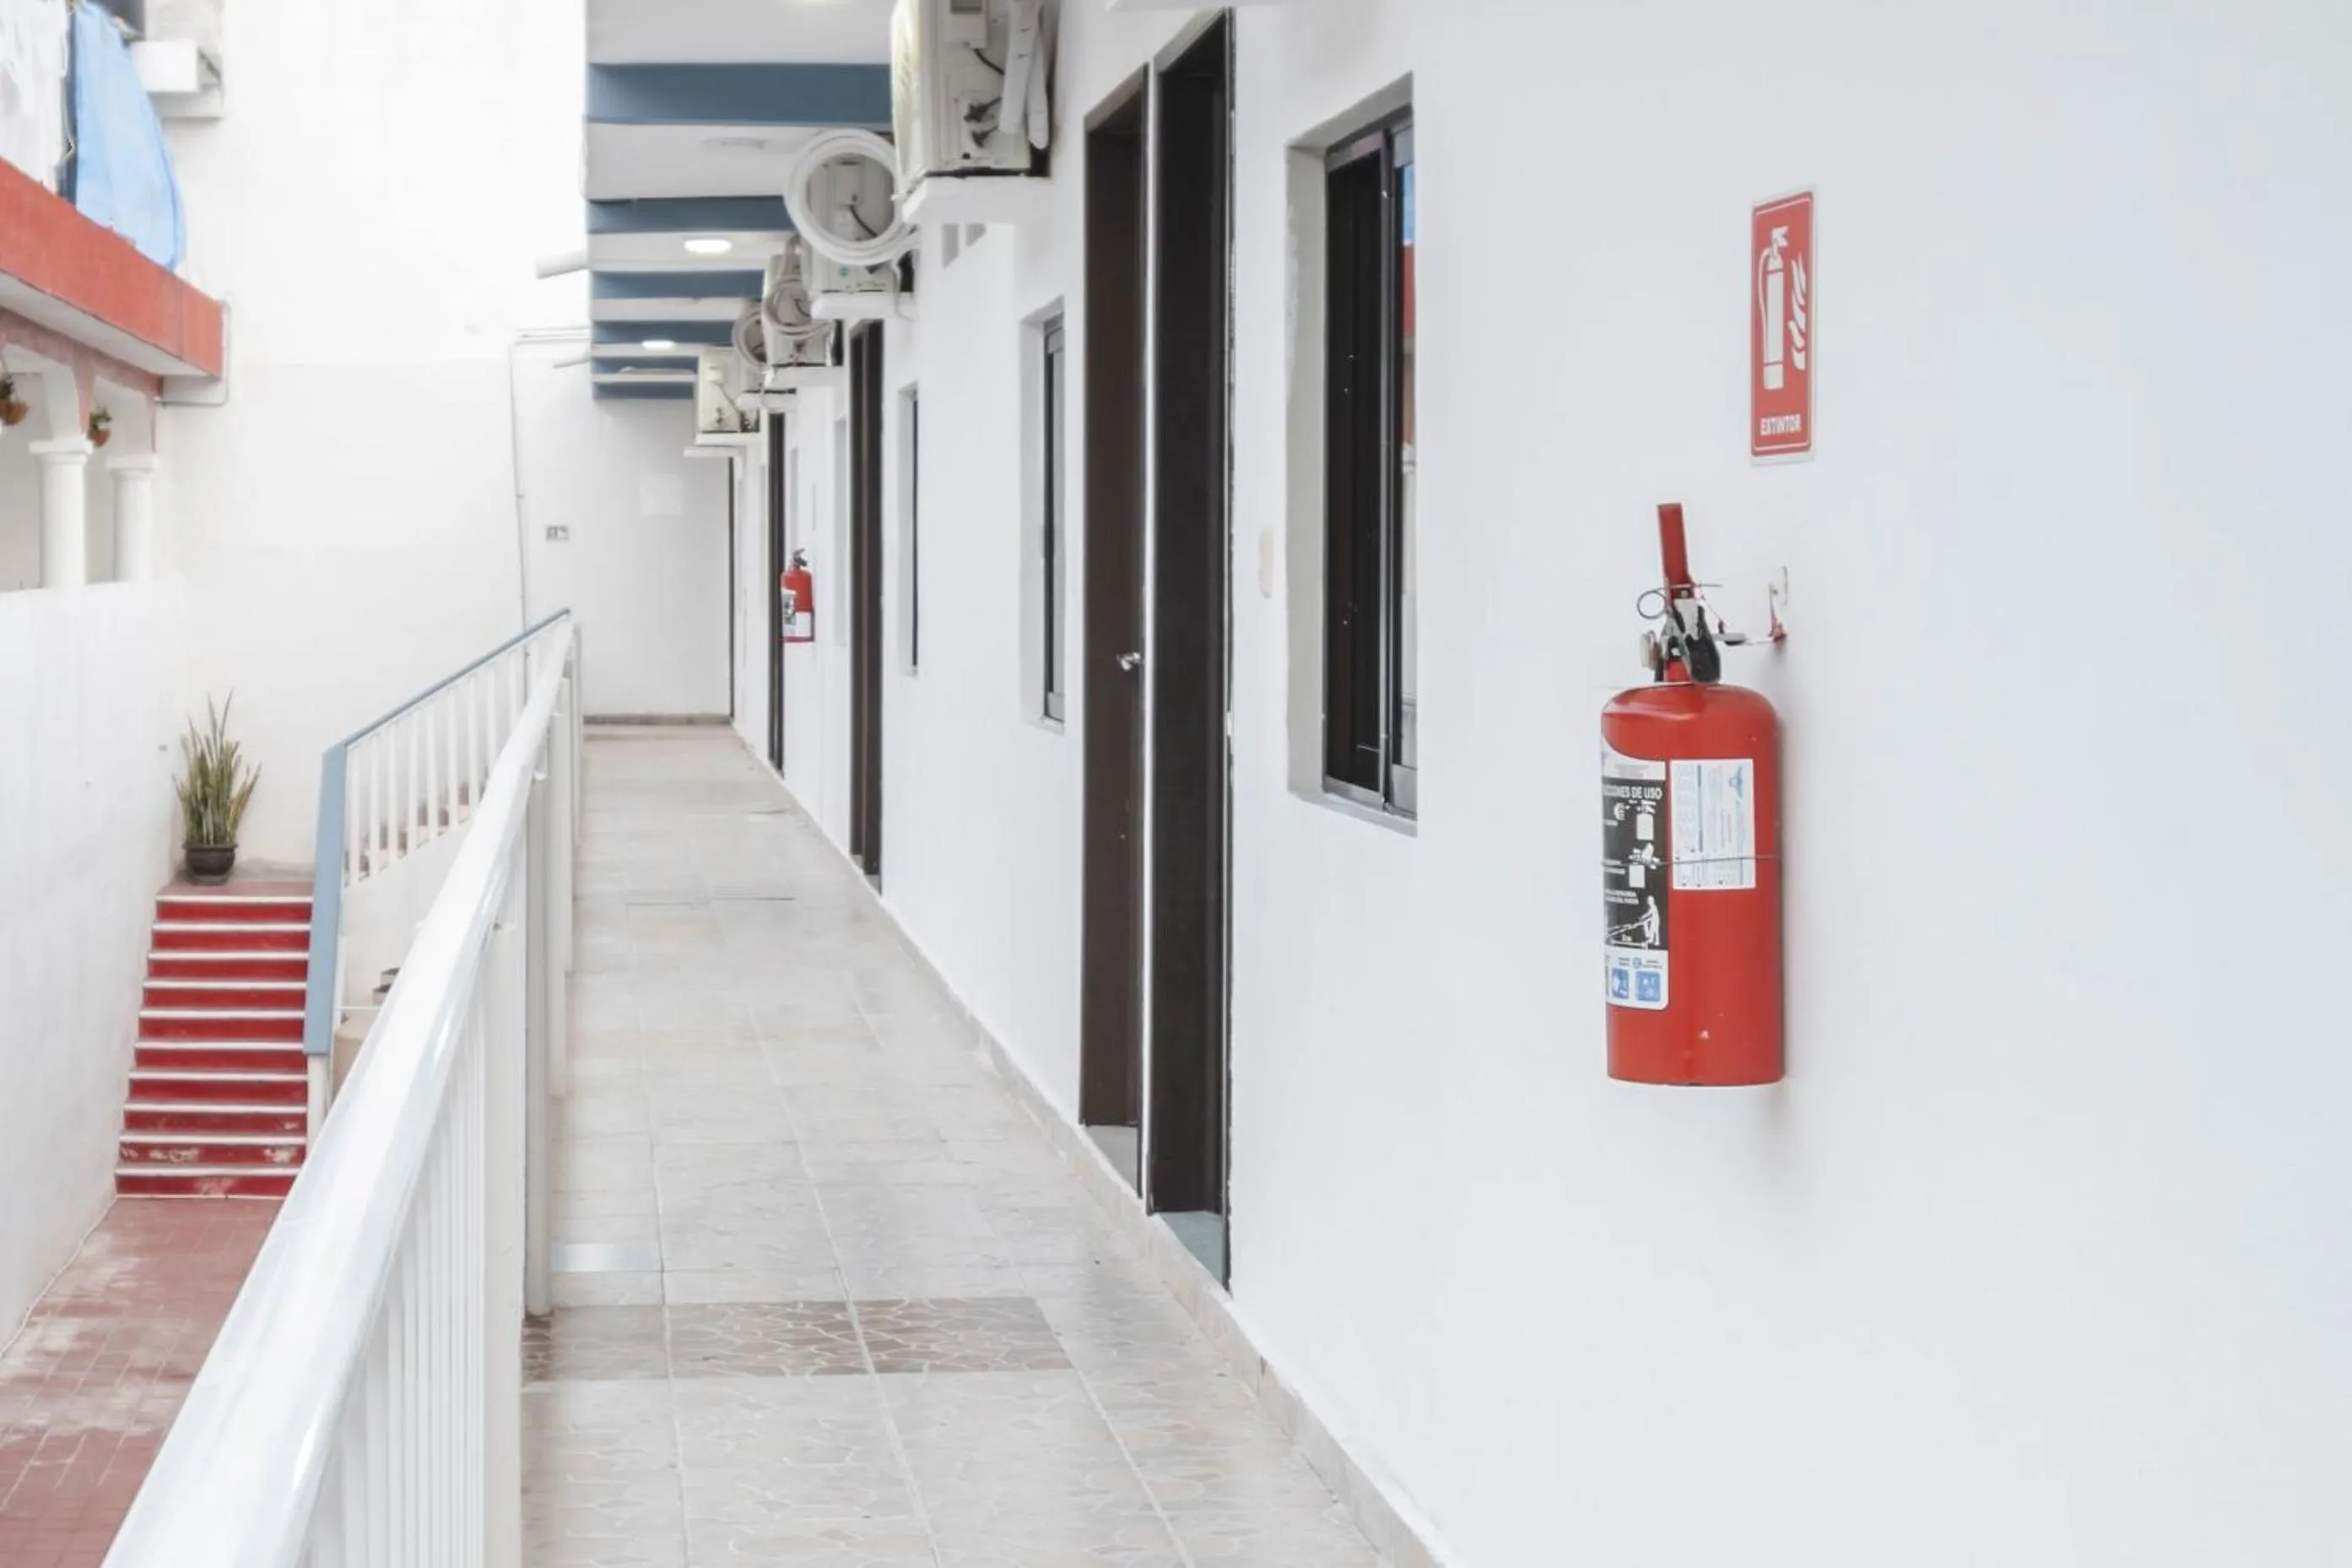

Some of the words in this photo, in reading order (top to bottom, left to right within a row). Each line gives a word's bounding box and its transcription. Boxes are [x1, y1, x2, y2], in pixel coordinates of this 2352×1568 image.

[1760, 414, 1801, 435] EXTINTOR
[1631, 786, 1642, 798] DE
[1644, 787, 1663, 800] USO
